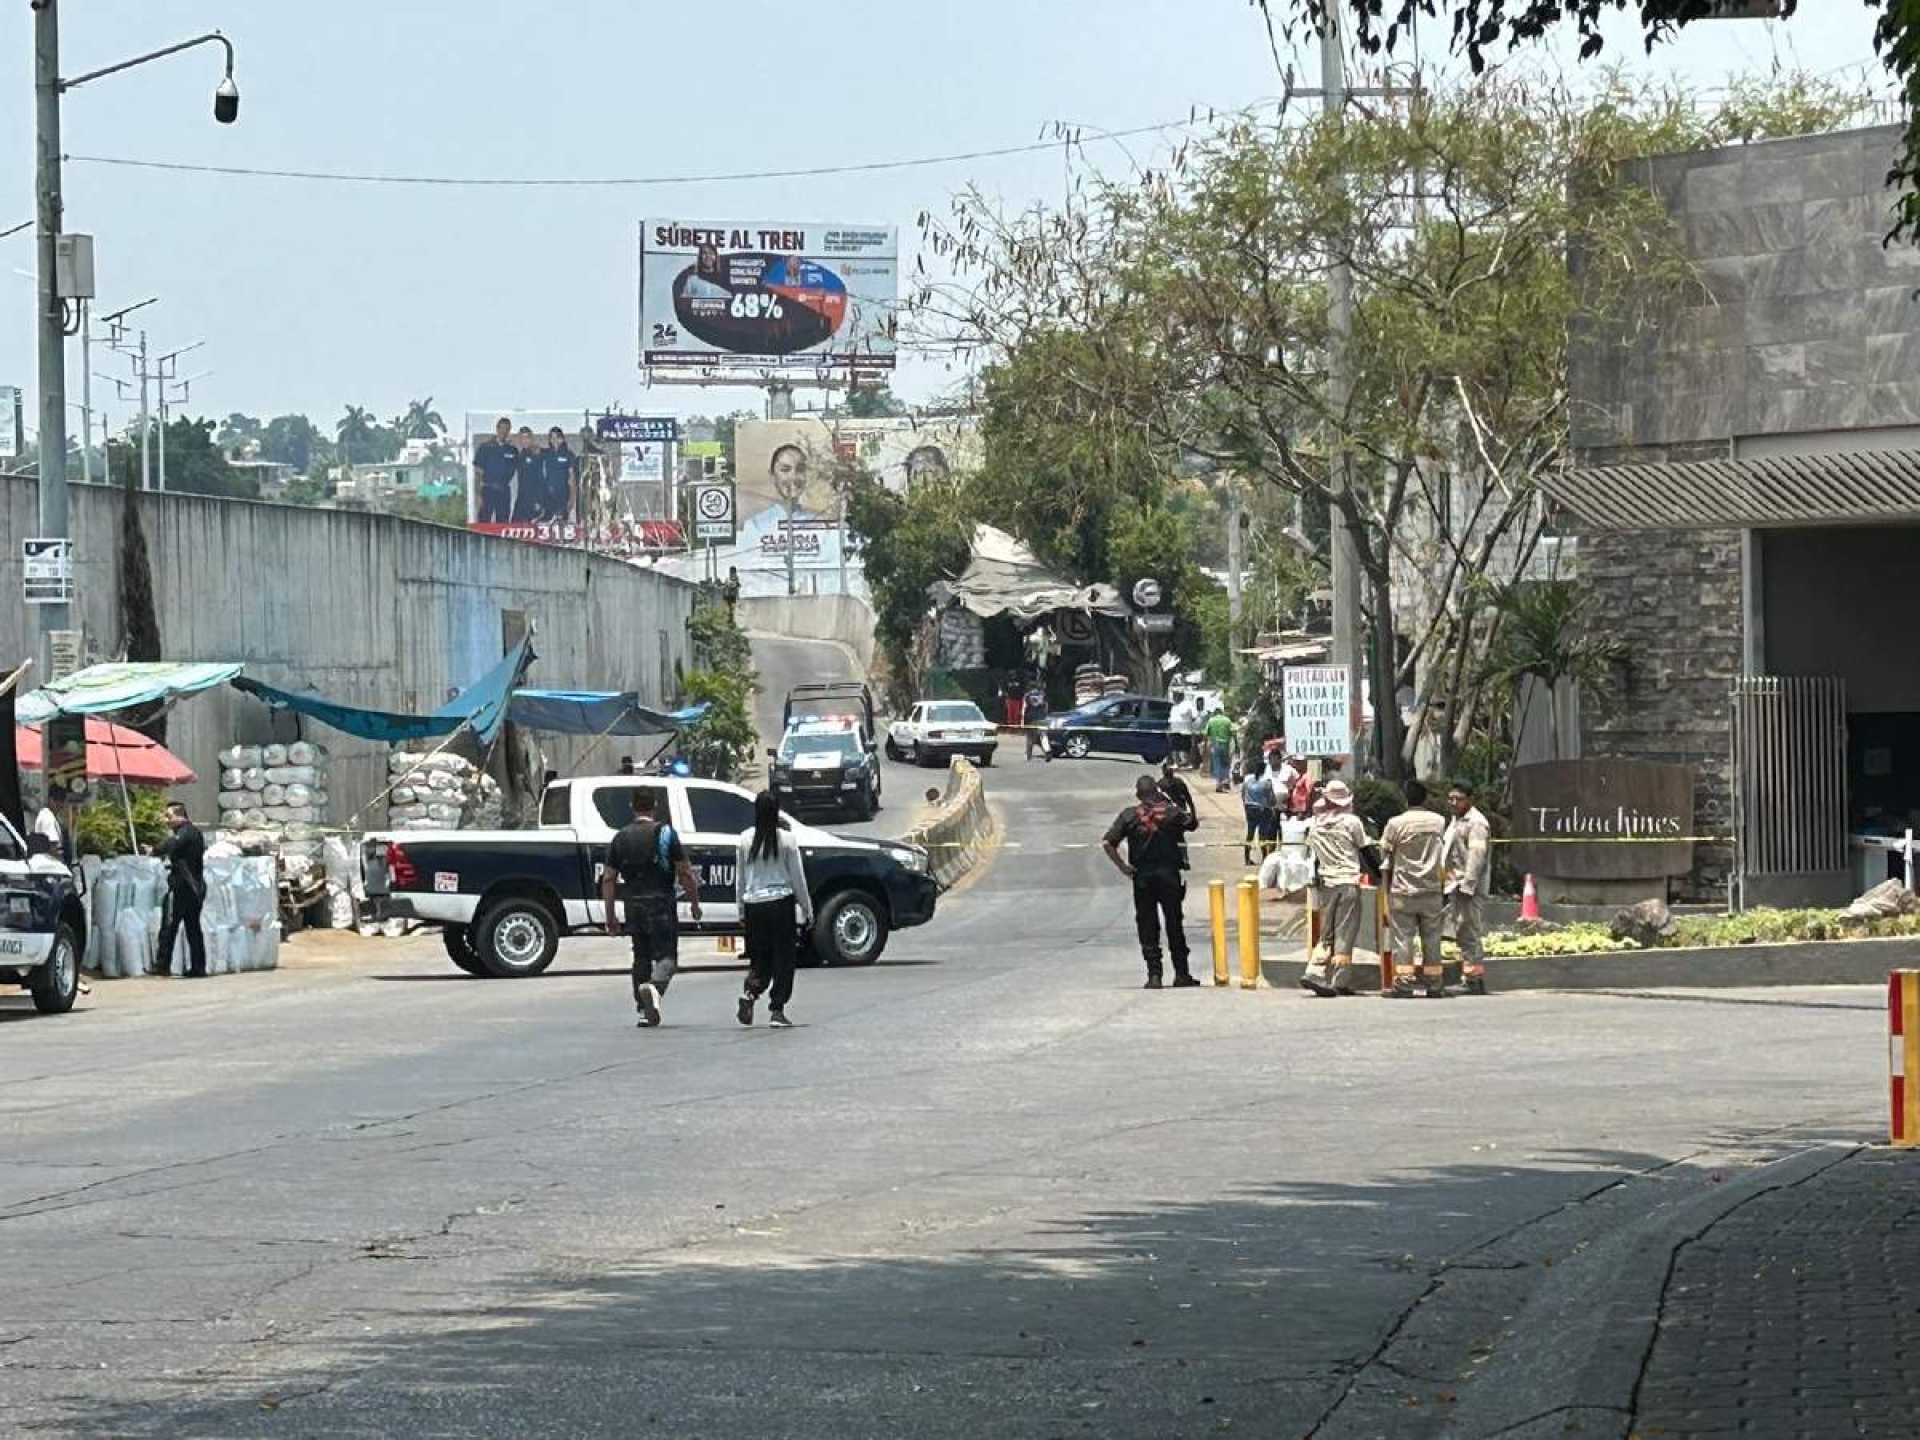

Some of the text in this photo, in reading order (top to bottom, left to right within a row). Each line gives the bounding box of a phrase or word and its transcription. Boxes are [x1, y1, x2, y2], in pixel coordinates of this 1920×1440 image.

[730, 230, 753, 249] AL
[757, 230, 805, 250] TREN
[730, 293, 783, 319] 68%
[1287, 685, 1327, 700] SALIDA
[1528, 806, 1681, 836] Tabachines
